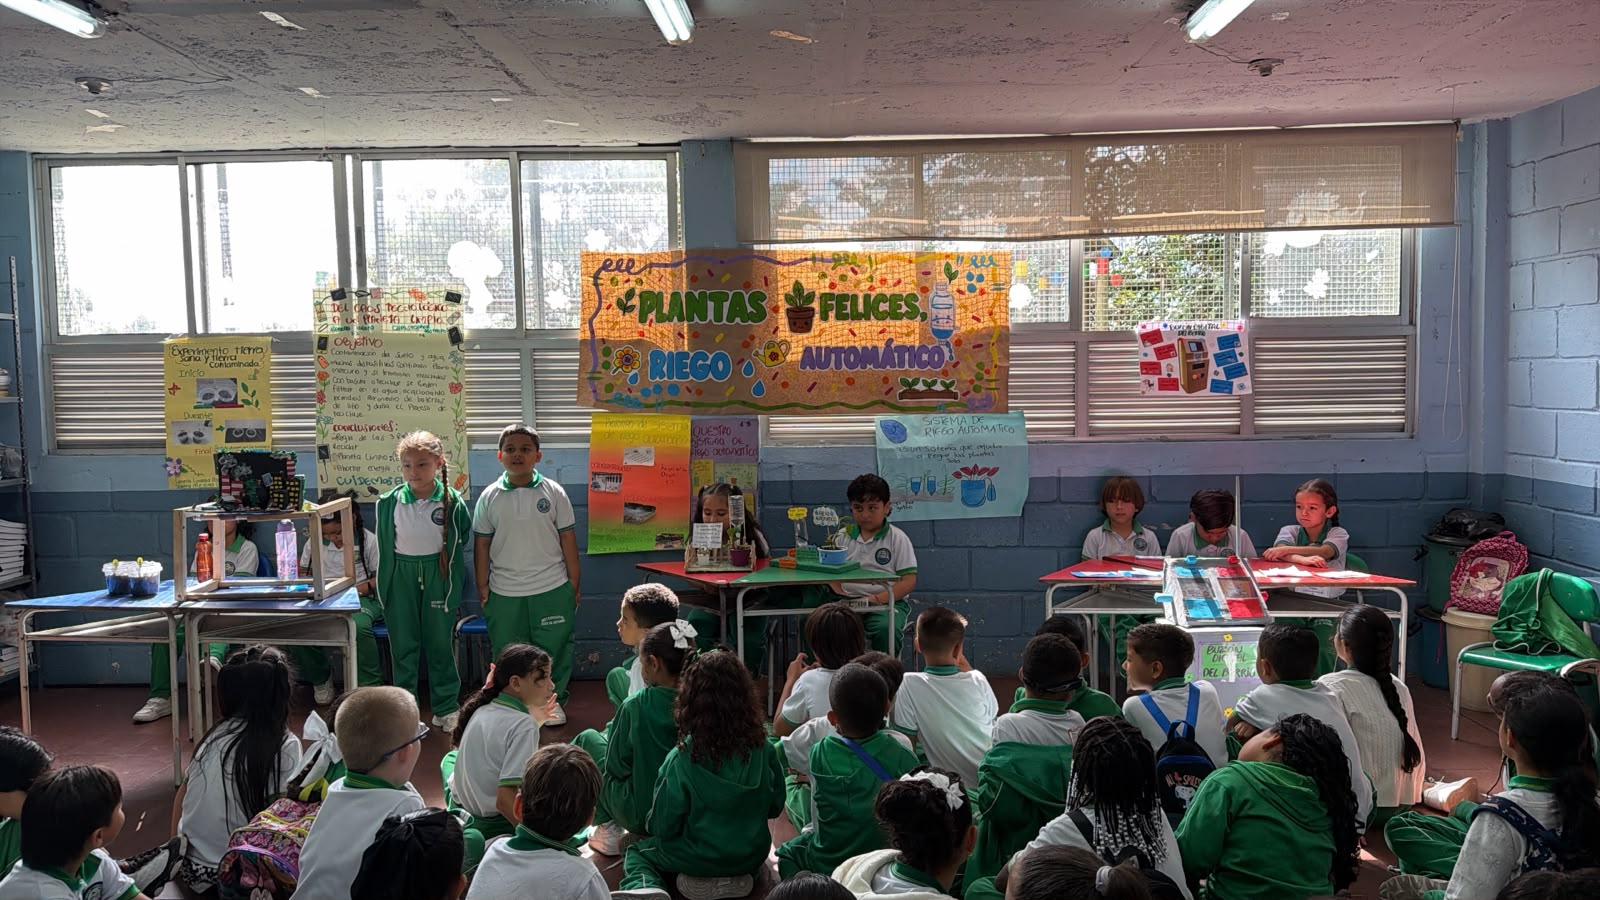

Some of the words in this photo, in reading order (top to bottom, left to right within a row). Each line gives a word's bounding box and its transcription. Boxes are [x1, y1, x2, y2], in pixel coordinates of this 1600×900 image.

[331, 303, 348, 313] DEL
[354, 303, 381, 313] CAOS
[638, 291, 768, 323] PLANTAS
[820, 292, 928, 322] FELICES,
[332, 315, 340, 324] A
[171, 345, 229, 356] Experimento
[235, 346, 264, 355] tierra
[205, 355, 210, 364] y
[212, 354, 237, 362] tierra
[649, 350, 732, 381] RIEGO
[800, 338, 945, 370] AUTOMÁTICO
[179, 369, 205, 377] Inicio
[183, 412, 213, 420] Durante
[972, 416, 984, 425] DE
[1203, 667, 1219, 677] DEL
